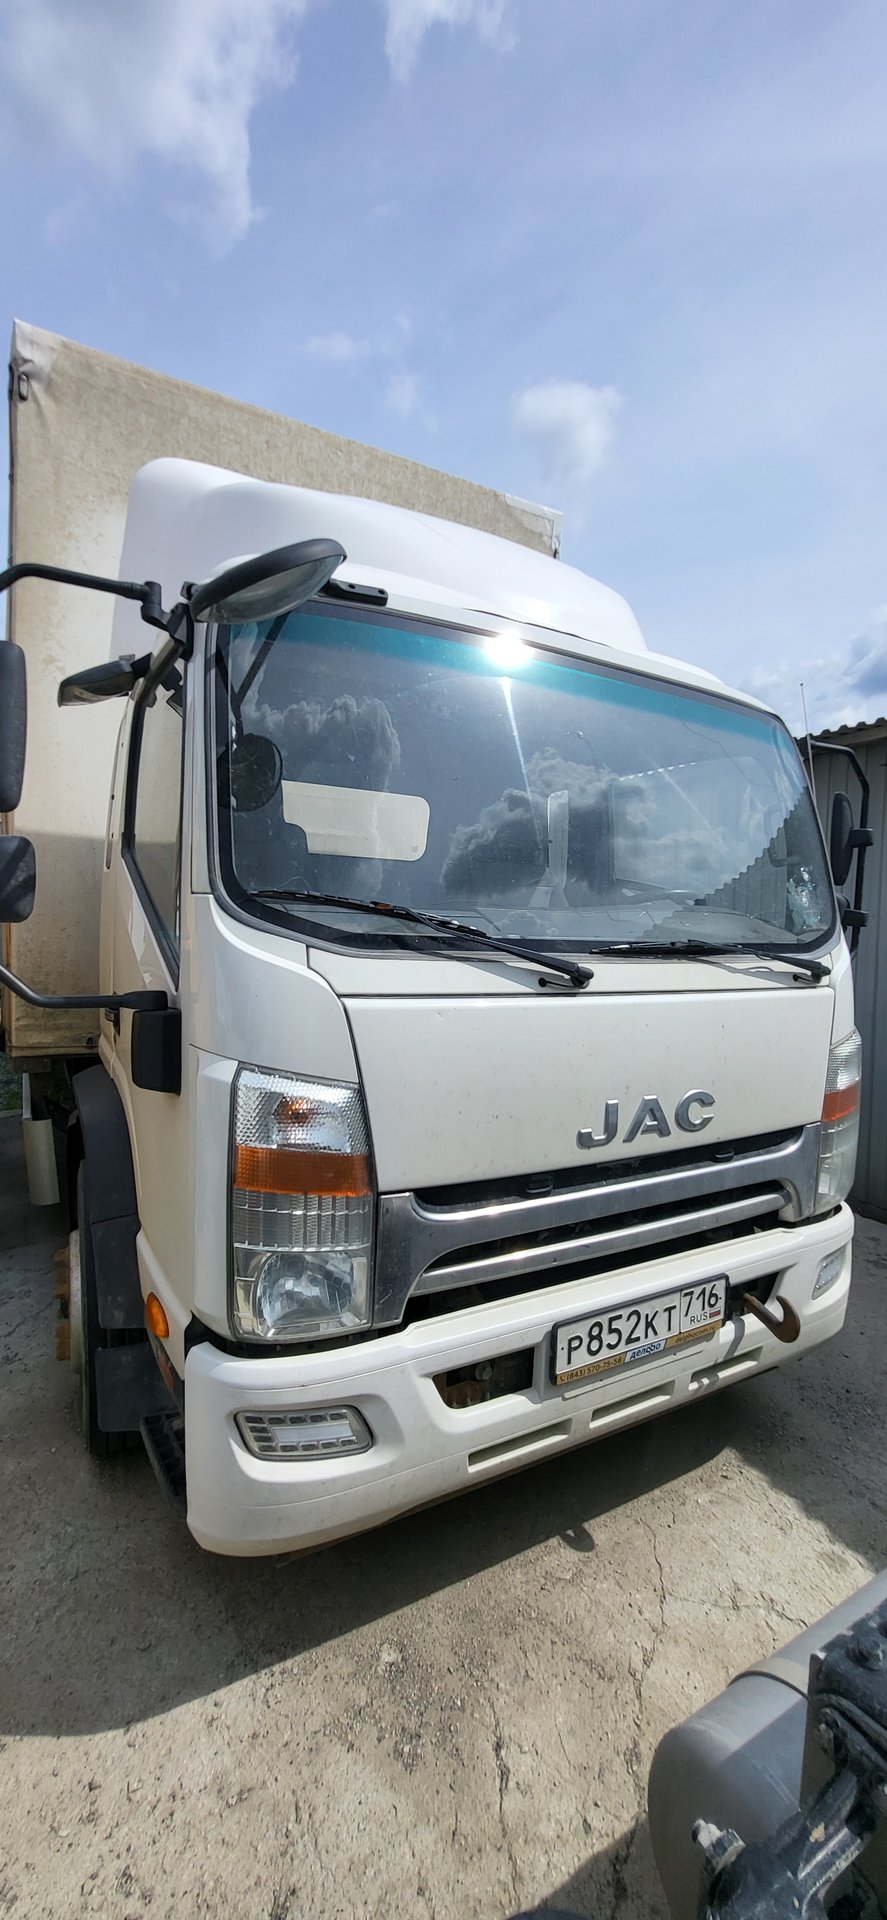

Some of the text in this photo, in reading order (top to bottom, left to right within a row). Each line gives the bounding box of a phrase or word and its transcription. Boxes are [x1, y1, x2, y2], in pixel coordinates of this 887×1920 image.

[576, 1089, 716, 1150] JAC
[682, 1283, 720, 1317] 716
[689, 1311, 709, 1325] RUS
[566, 1356, 623, 1381] (843) 570-75-56
